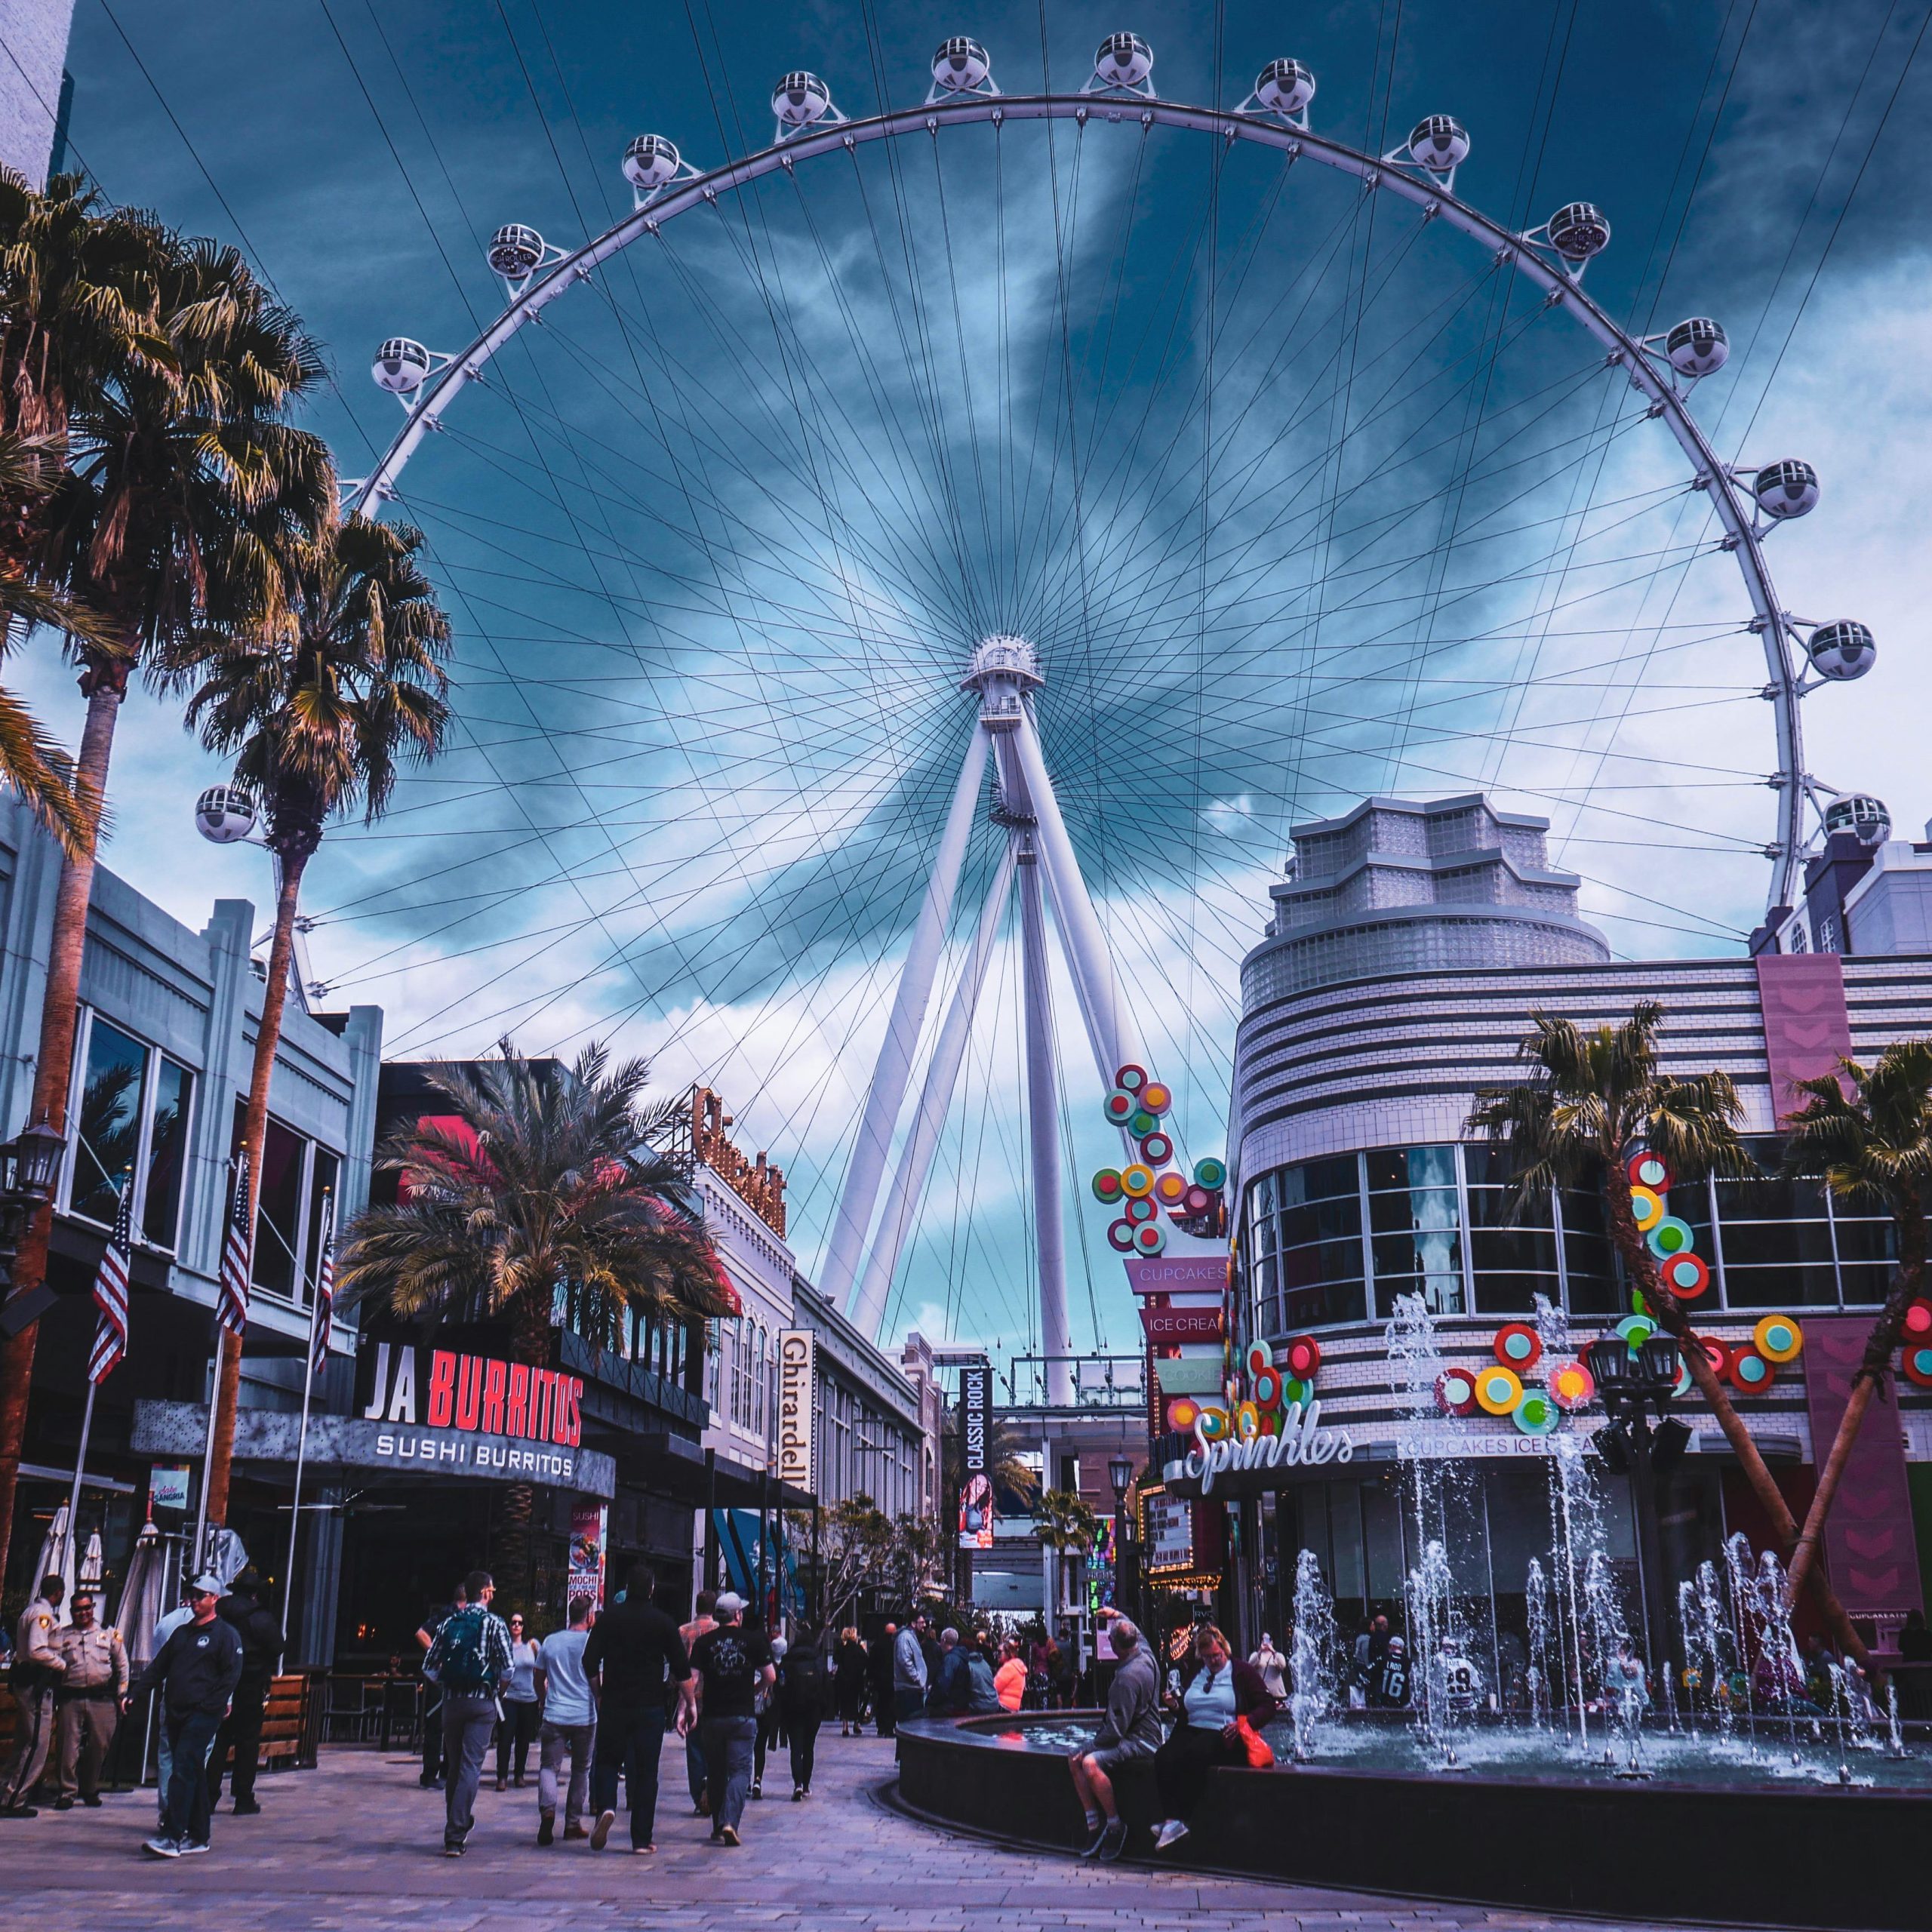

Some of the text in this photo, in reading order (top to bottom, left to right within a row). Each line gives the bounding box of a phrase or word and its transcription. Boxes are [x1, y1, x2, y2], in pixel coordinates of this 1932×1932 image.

[1140, 1267, 1227, 1281] CUPCAKES
[1149, 1318, 1220, 1331] ICE CREA
[781, 1337, 808, 1491] Ghirardell
[967, 1371, 984, 1469] CLASSIC ROCK
[1186, 1399, 1371, 1496] Sprinkles
[1407, 1438, 1509, 1455] CUPCAKES
[1513, 1438, 1543, 1454] ICE
[376, 1434, 573, 1477] SUSHI BURRITOS
[154, 1492, 184, 1502] SANGRIA
[573, 1512, 598, 1521] SUSHI
[569, 1576, 597, 1585] MOCHI
[568, 1590, 596, 1601] POPS
[1382, 1669, 1405, 1698] 16
